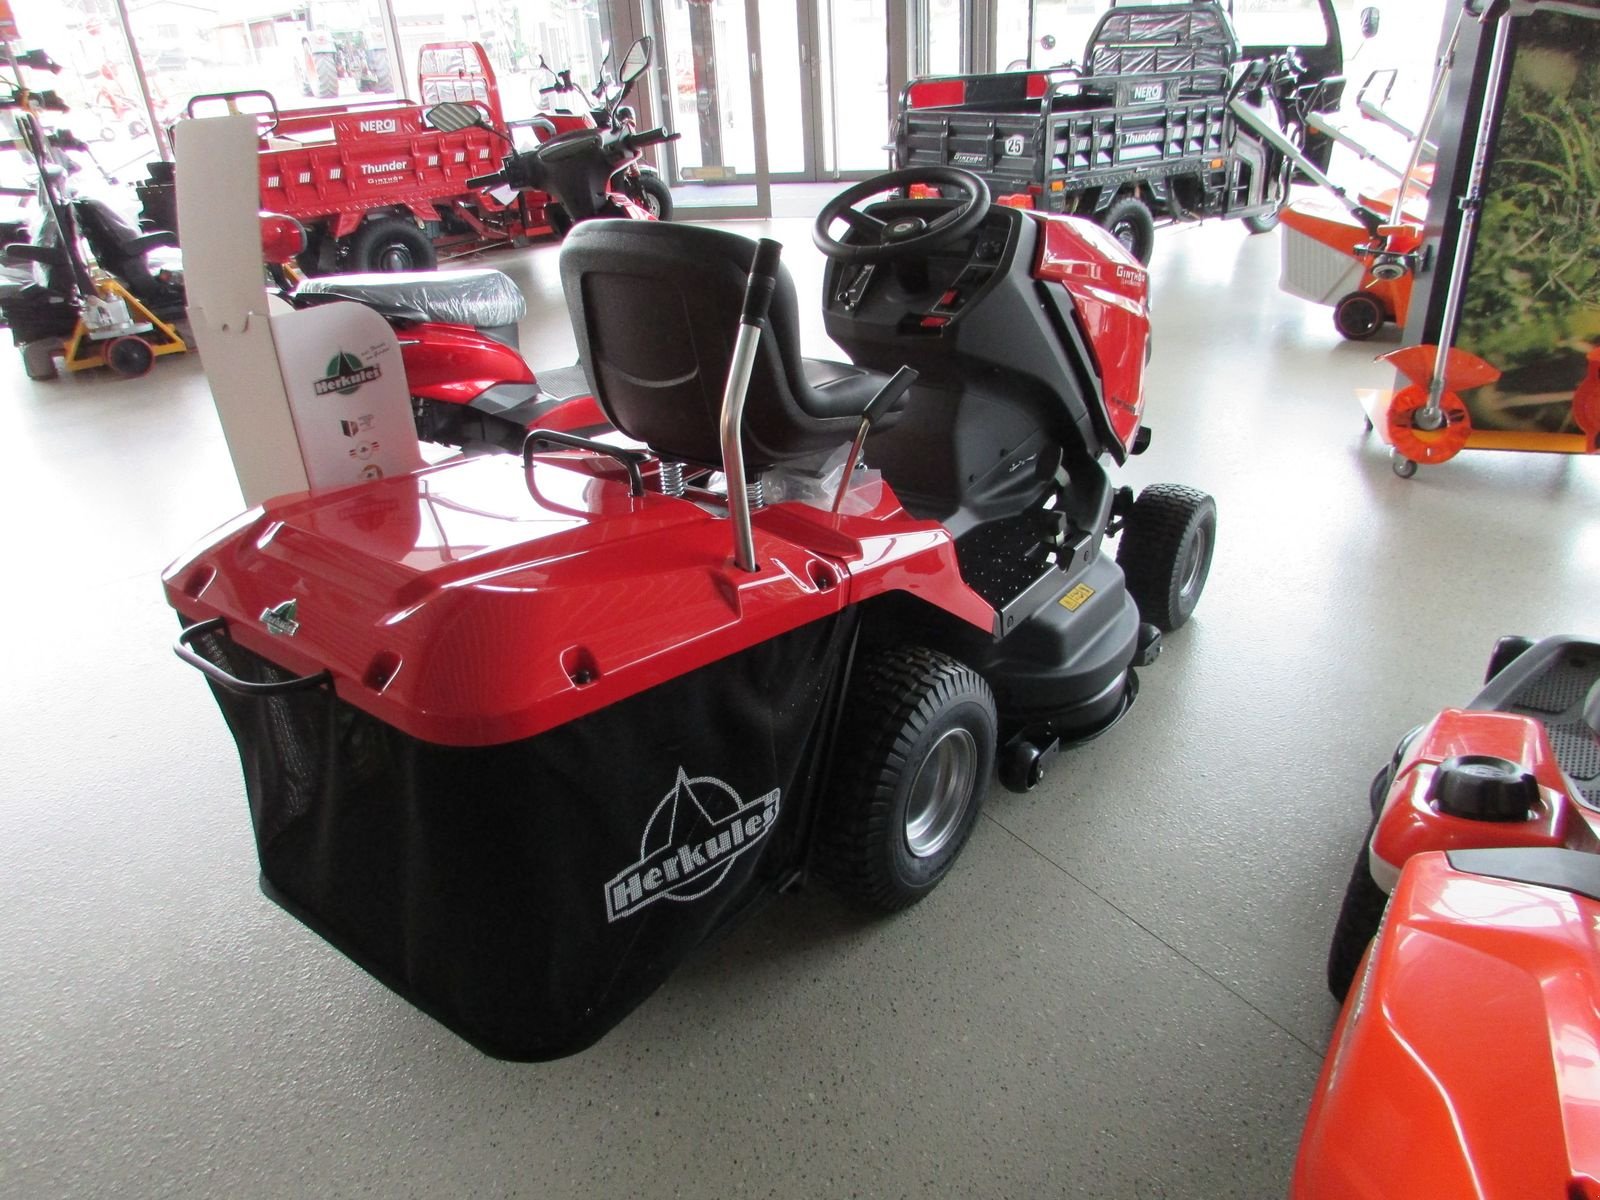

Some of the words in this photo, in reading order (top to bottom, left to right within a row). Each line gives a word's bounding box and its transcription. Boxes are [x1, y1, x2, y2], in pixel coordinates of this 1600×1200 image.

[1125, 131, 1159, 144] Thunder
[1007, 139, 1021, 153] 25
[361, 160, 407, 174] Thunder
[613, 805, 776, 910] Herkules
